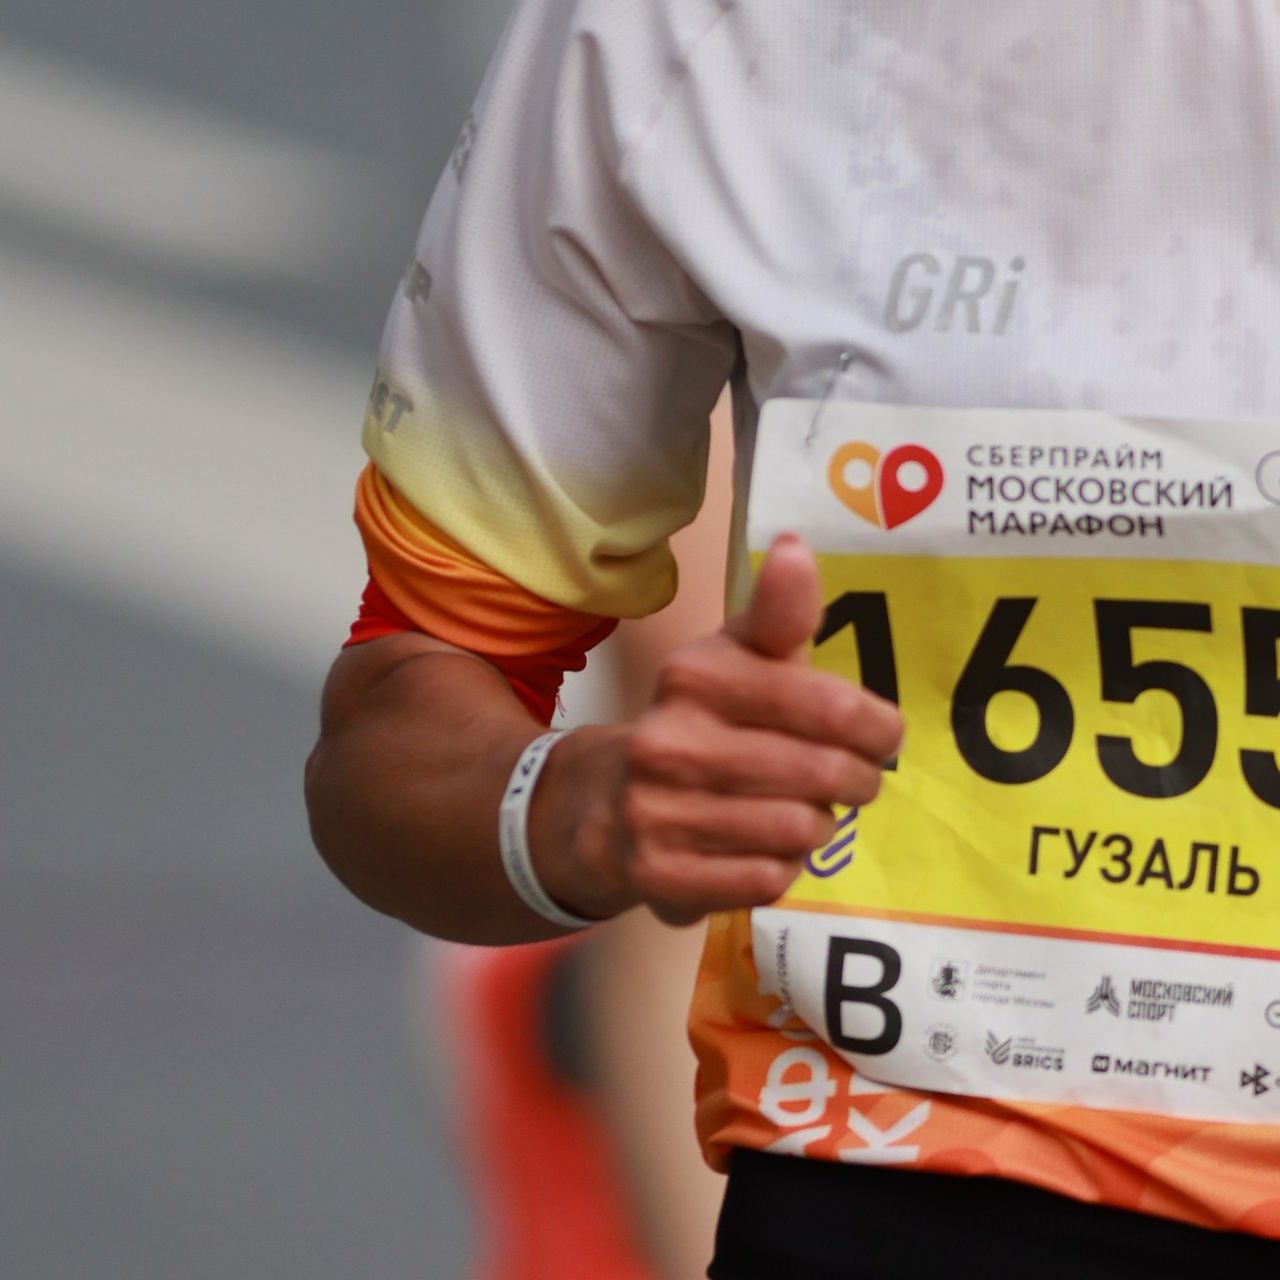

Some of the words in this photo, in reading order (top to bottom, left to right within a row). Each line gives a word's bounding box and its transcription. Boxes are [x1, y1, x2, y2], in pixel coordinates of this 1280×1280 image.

[966, 444, 1162, 469] СБЕРПРАЙМ
[967, 475, 1232, 508] МОСКОВСКИЙ
[968, 510, 1164, 537] МАРАФОН
[1028, 825, 1261, 897] ГУЗАЛЬ
[1128, 1000, 1176, 1021] СПОРТ
[1013, 1053, 1063, 1071] BRICS
